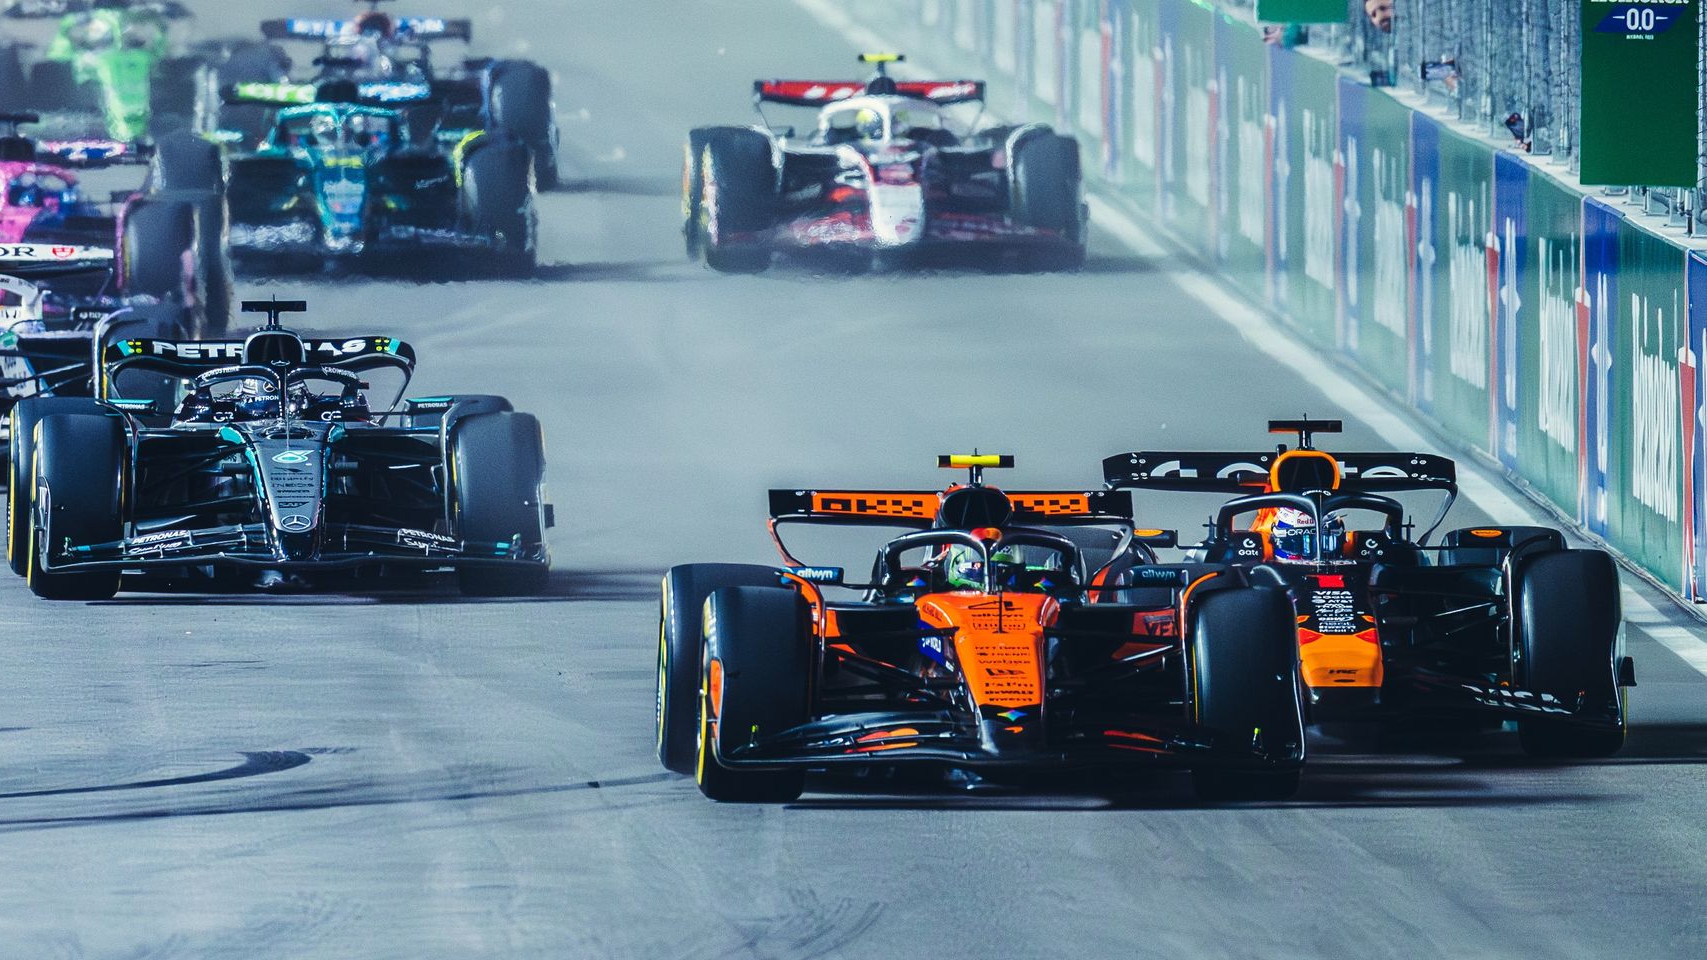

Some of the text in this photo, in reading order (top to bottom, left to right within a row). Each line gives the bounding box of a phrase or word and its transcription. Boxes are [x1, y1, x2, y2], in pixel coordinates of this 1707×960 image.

[1626, 8, 1654, 31] 0.0
[152, 339, 367, 359] PETRAS
[820, 497, 924, 516] OKX
[1013, 498, 1081, 514] KX
[1286, 528, 1317, 536] ORAC
[796, 568, 833, 581] allwyn
[1141, 569, 1176, 580] allwyn
